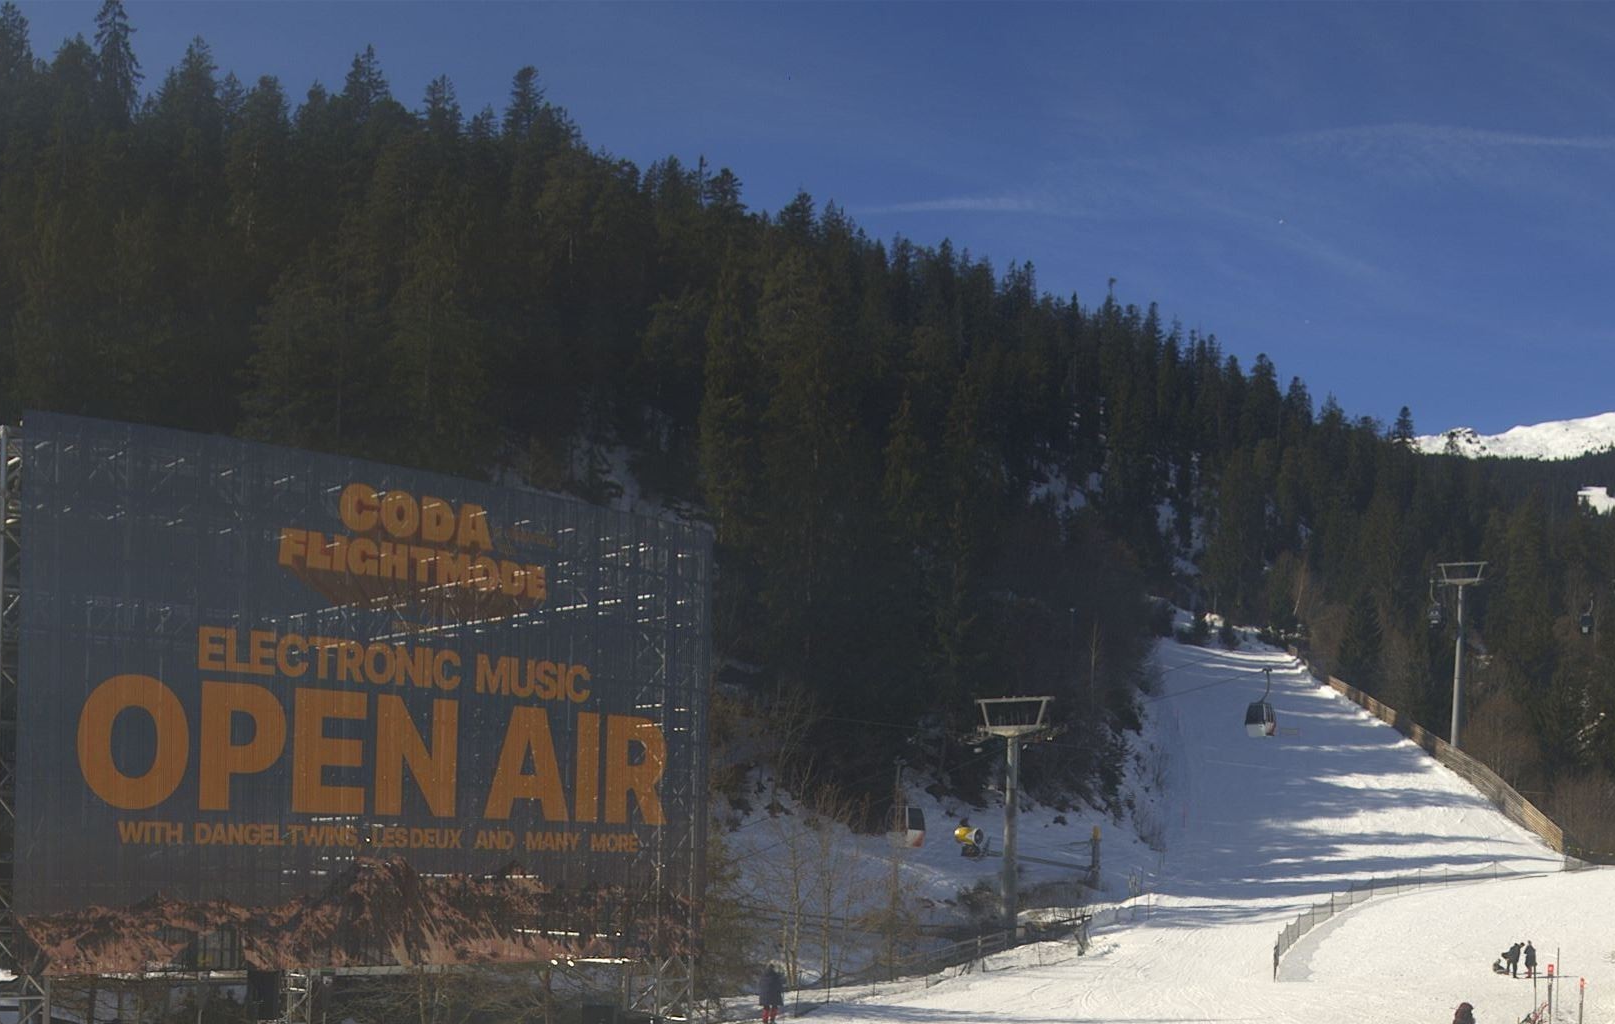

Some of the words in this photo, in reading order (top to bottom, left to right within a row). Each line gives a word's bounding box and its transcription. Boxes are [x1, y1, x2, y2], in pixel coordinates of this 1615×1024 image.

[339, 482, 493, 551] CODA
[278, 527, 547, 601] FLIGHTMODE
[198, 626, 461, 692] ELECTRONIC
[475, 654, 591, 703] MUSIC
[77, 674, 459, 818] OPEN
[483, 705, 667, 826] AIR
[117, 820, 183, 846] WITH
[194, 823, 283, 846] DANGEL
[475, 829, 517, 850] AND
[524, 831, 581, 851] MANY
[590, 832, 639, 852] MORE
